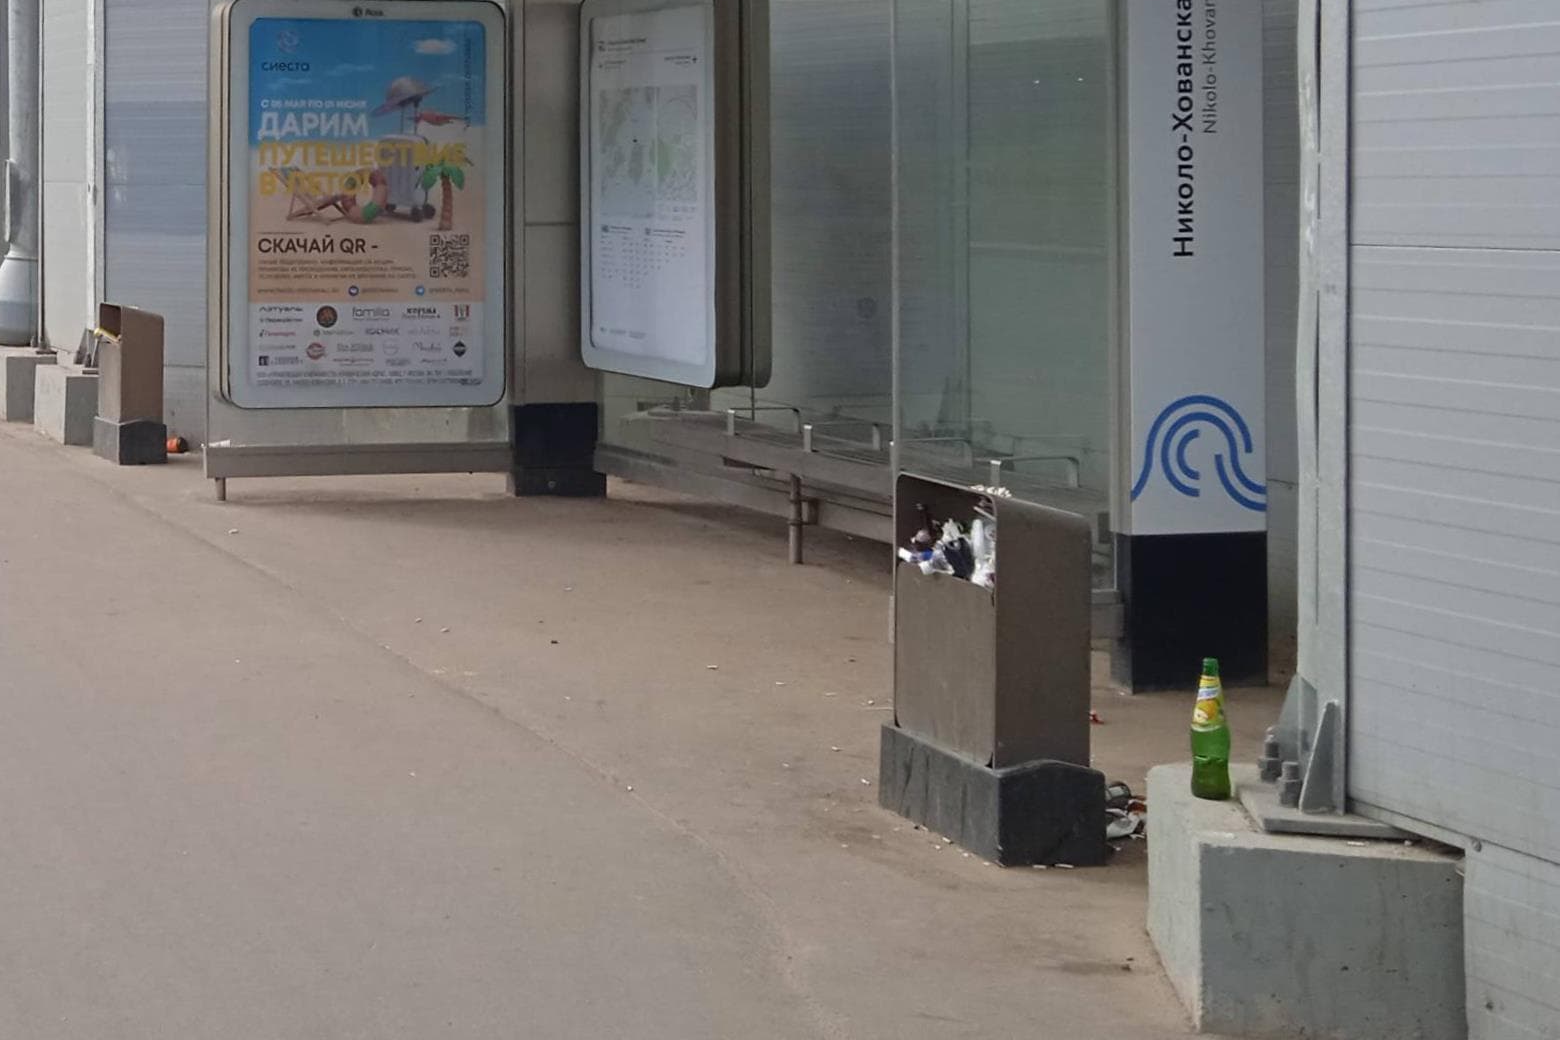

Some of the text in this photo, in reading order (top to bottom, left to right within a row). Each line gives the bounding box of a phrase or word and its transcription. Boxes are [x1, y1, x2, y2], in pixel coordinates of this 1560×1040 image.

[258, 112, 369, 140] ДАРИМ
[259, 143, 469, 167] ПУТЕШЕСТВИЕ
[259, 171, 277, 196] В
[258, 234, 334, 253] СКАЧАЙ
[340, 238, 366, 254] QR
